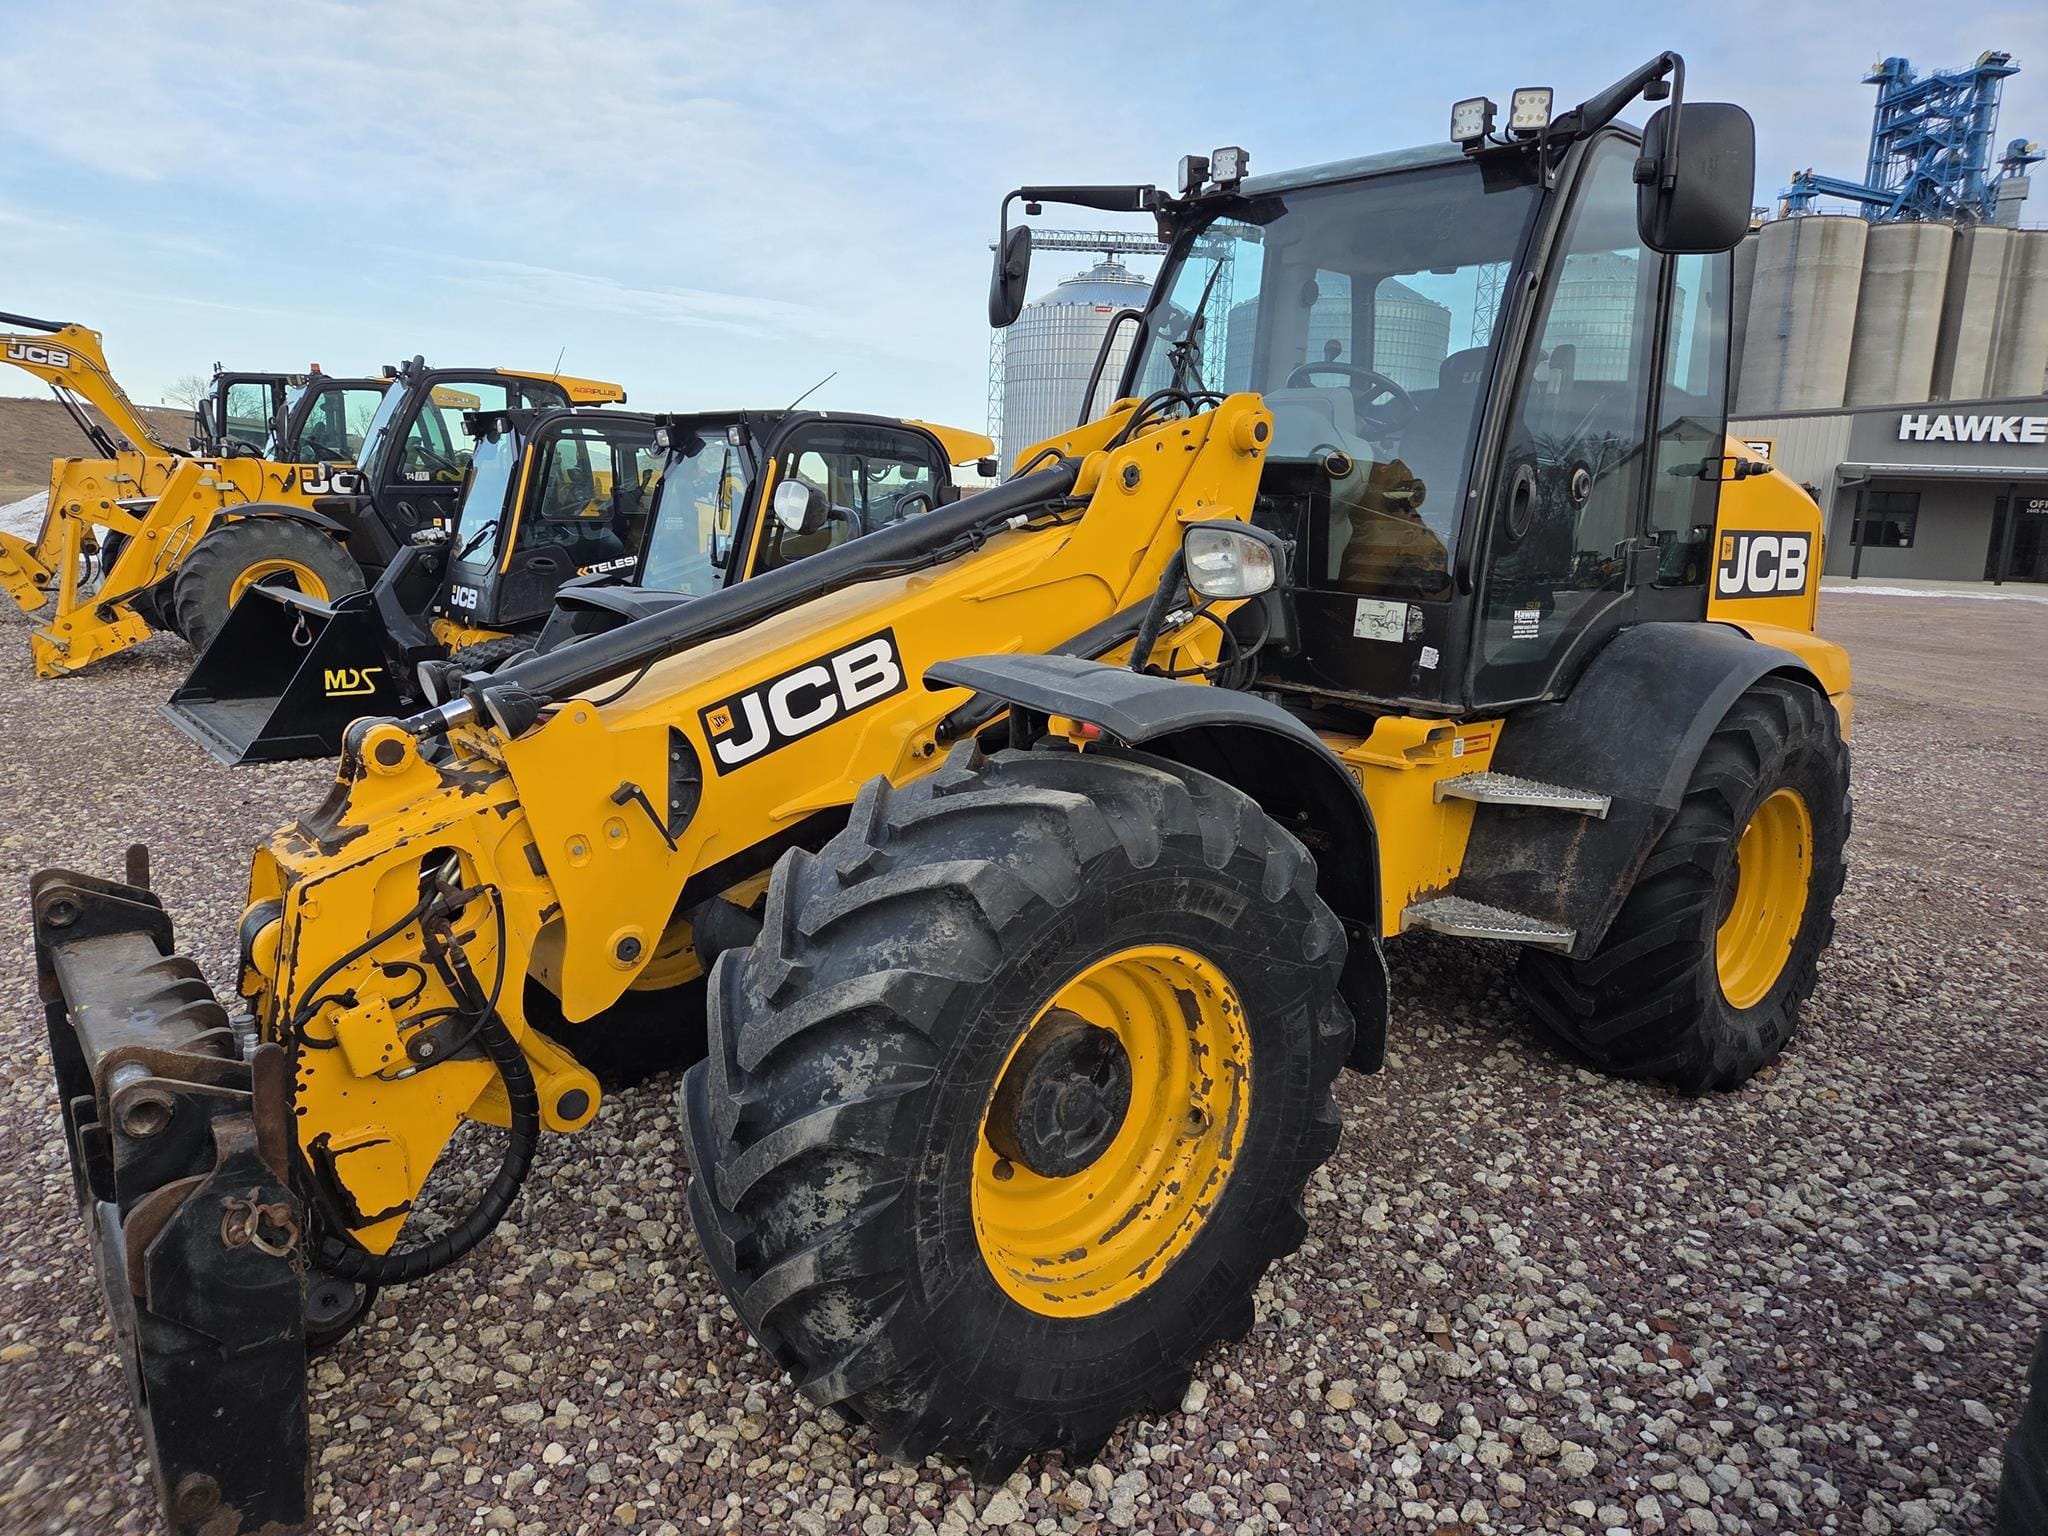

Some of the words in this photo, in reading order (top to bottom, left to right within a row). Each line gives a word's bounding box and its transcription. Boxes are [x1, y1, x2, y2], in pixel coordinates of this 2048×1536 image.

[7, 345, 69, 367] JCB
[1899, 414, 2048, 443] HAWKE
[1719, 536, 1807, 593] JCB
[451, 584, 478, 610] JCB
[715, 638, 901, 764] JCB
